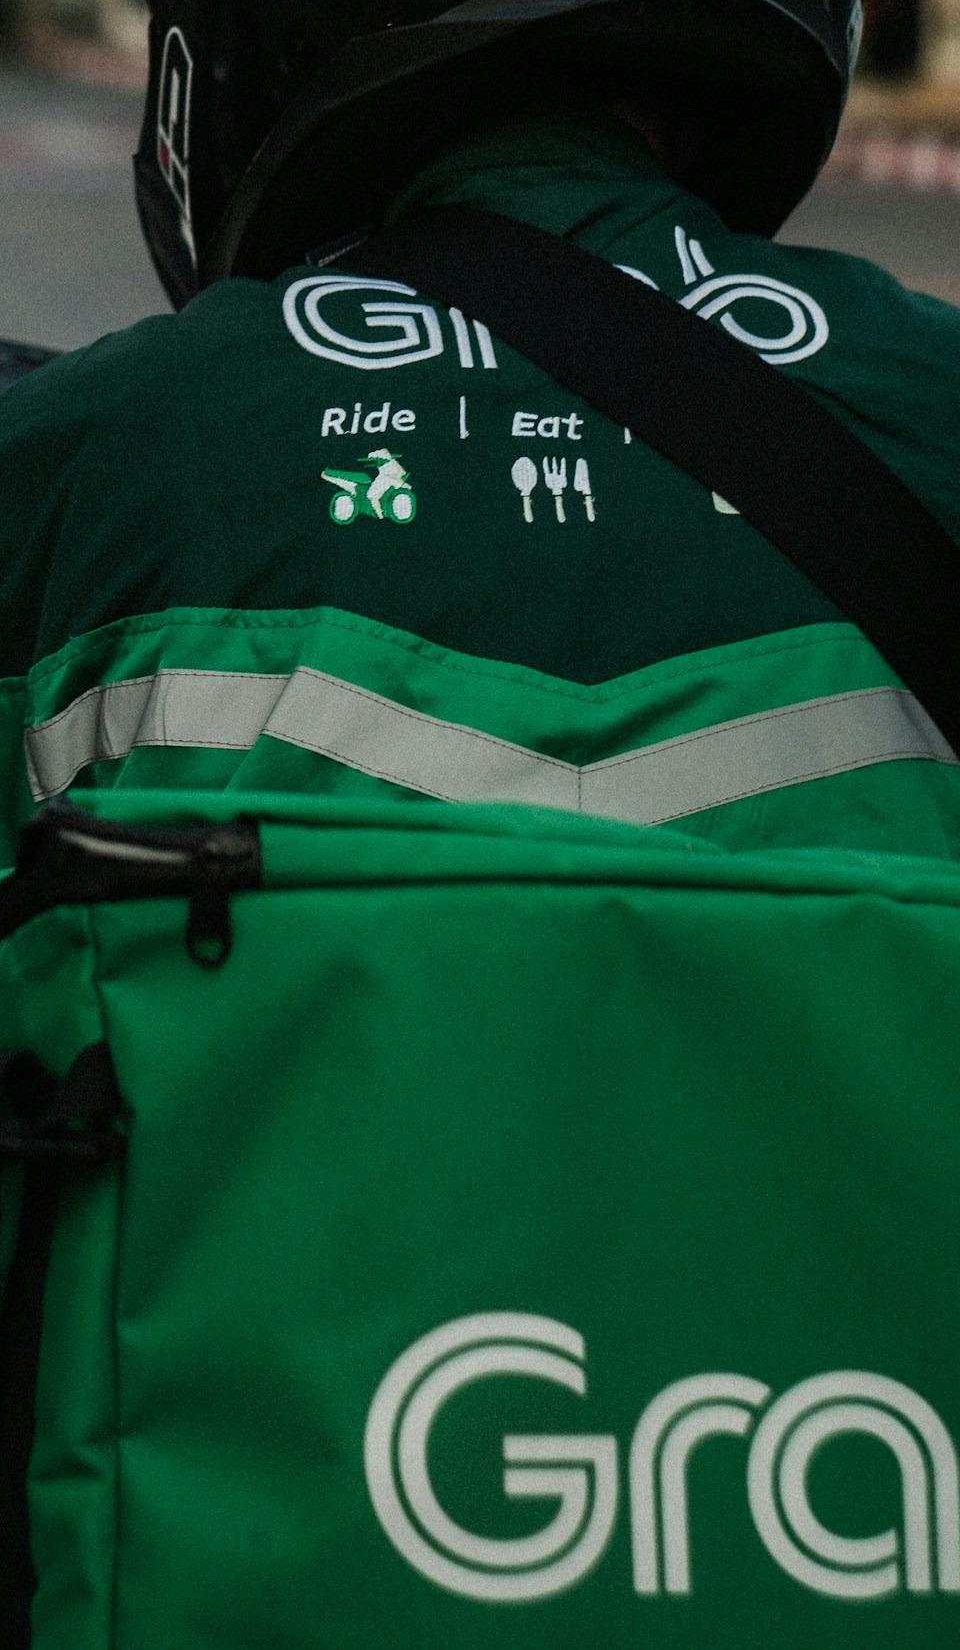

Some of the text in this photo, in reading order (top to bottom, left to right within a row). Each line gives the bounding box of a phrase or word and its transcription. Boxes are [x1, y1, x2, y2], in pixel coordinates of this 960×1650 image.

[321, 401, 584, 440] Ride Eat
[363, 1310, 960, 1602] Gra
